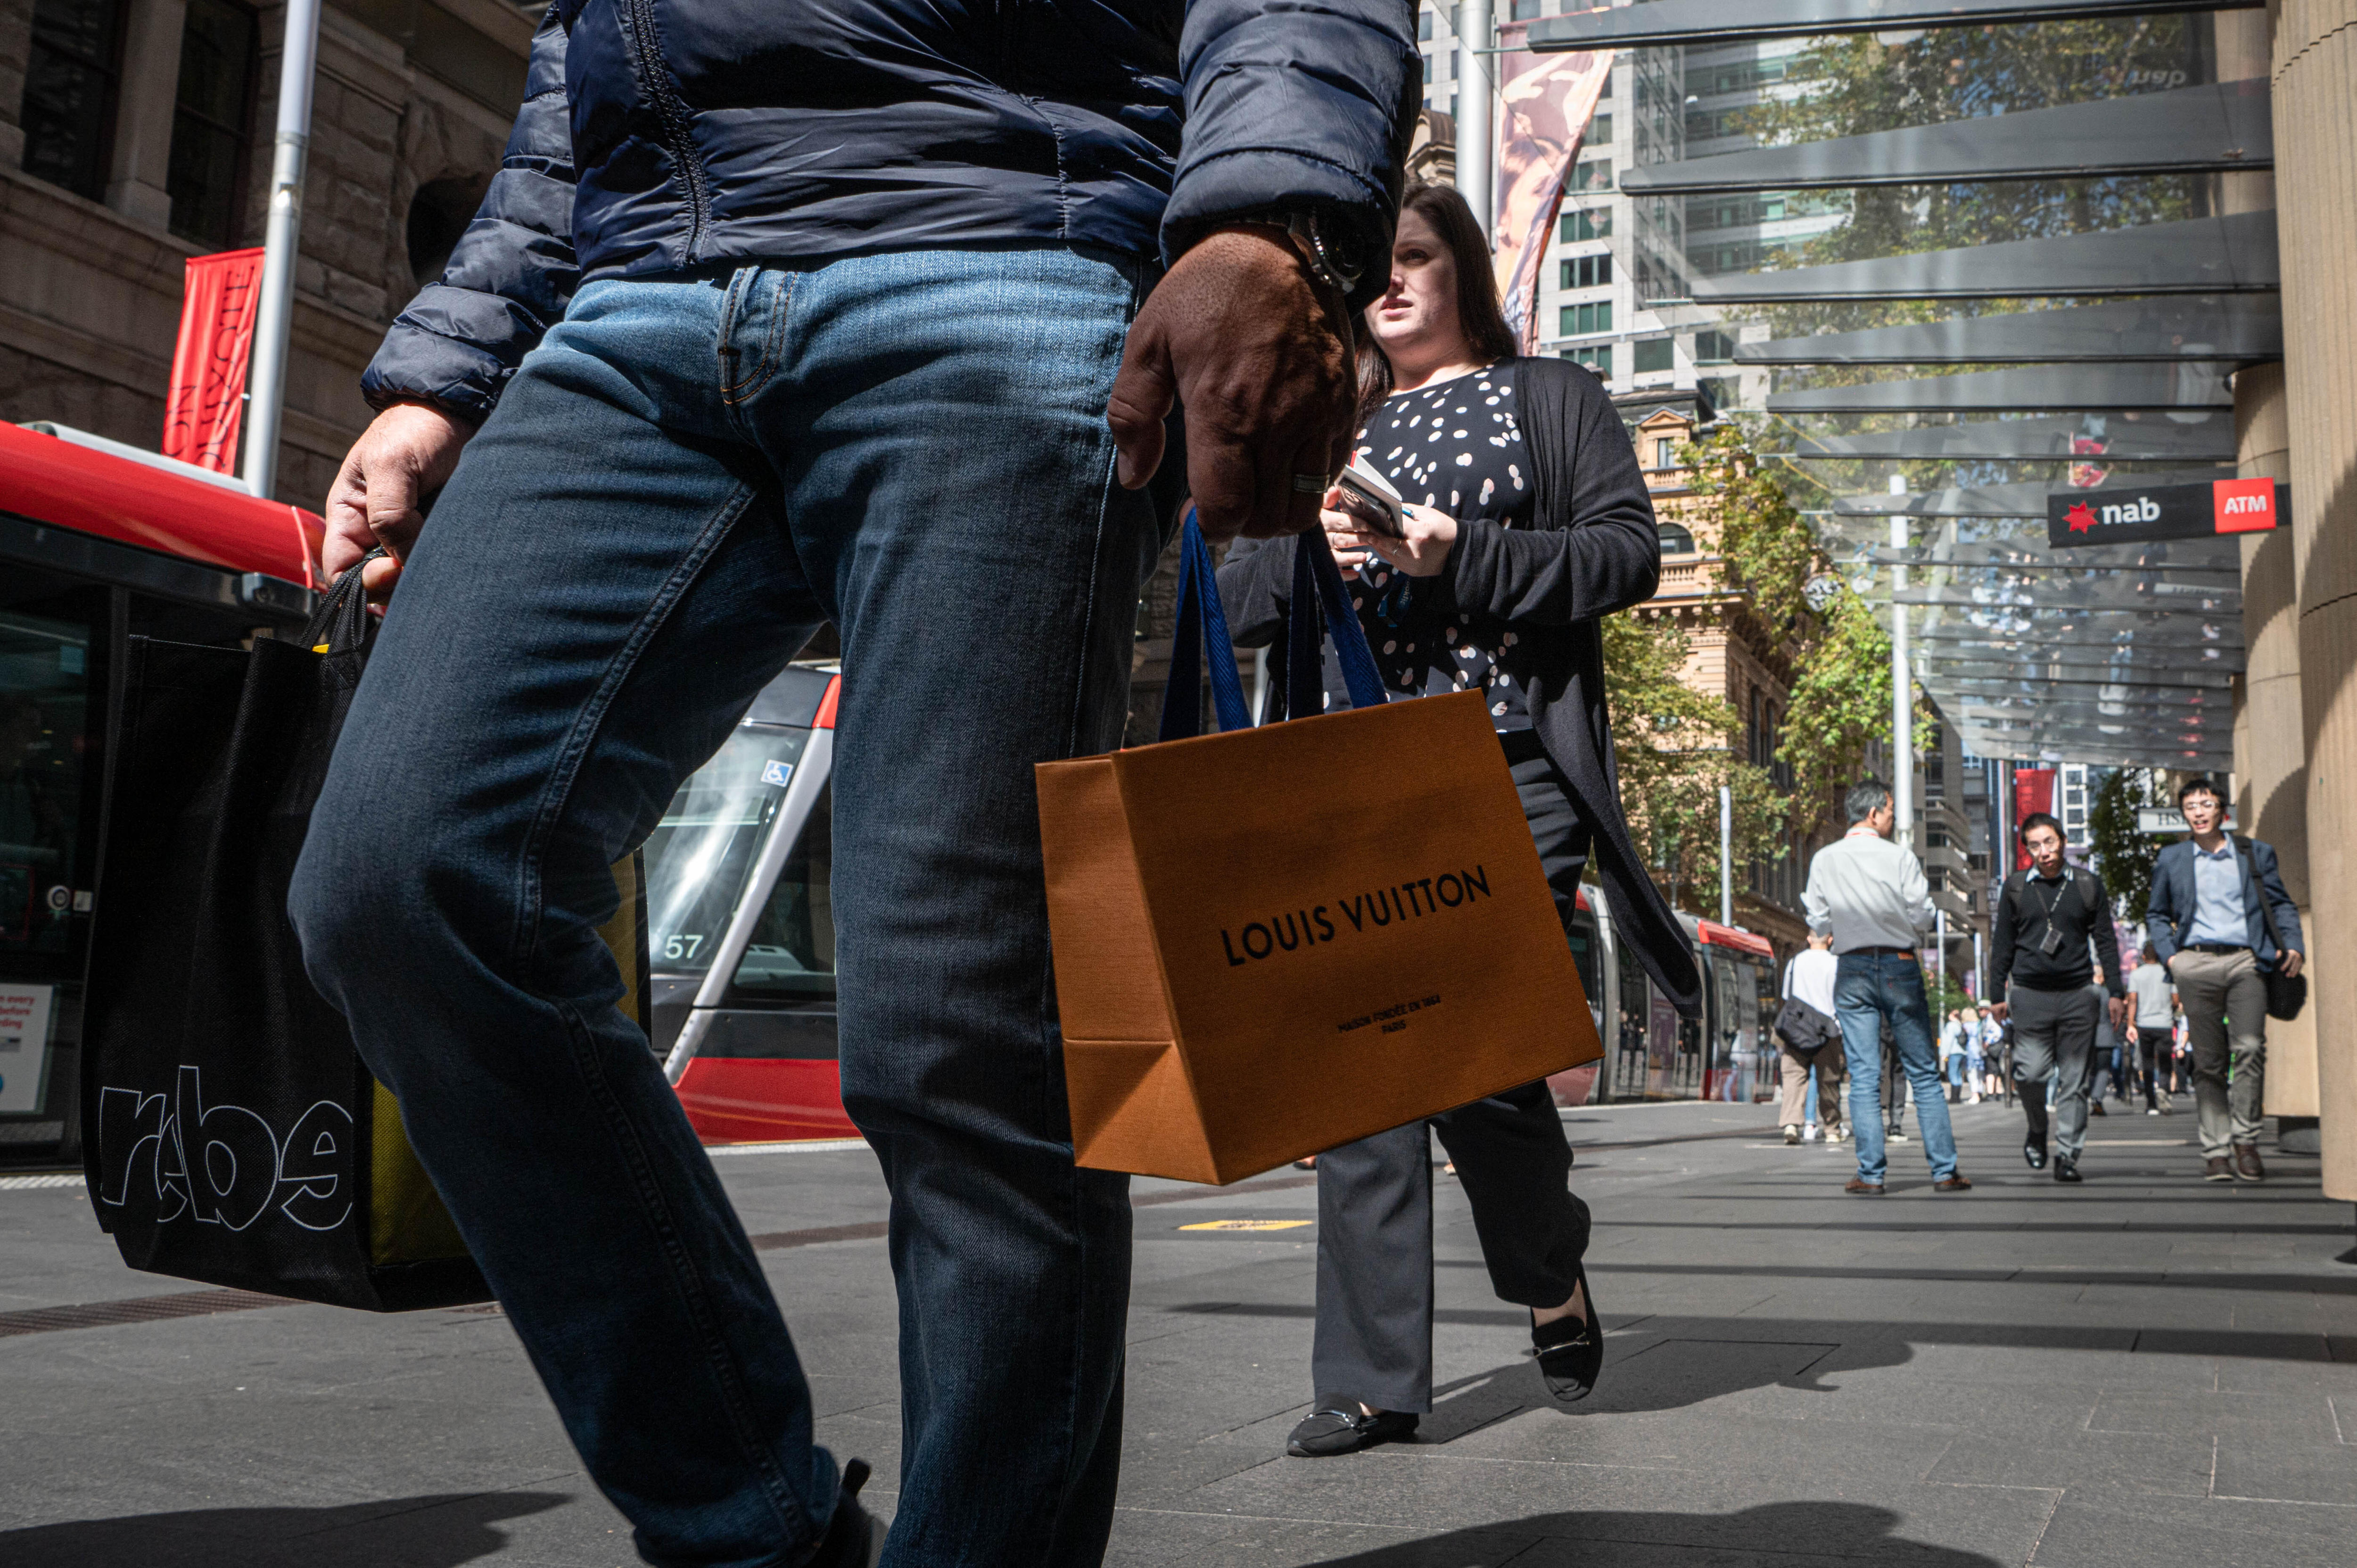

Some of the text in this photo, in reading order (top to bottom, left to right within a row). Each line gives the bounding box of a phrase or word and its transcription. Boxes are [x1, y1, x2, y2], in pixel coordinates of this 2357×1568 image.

[164, 384, 198, 458] ON
[2102, 496, 2161, 525] nab
[2224, 494, 2267, 515] ATM
[1220, 865, 1491, 967] LOUIS VUITTON
[664, 934, 704, 959] 57
[7, 996, 35, 1006] every
[1381, 1019, 1407, 1034] PARIS
